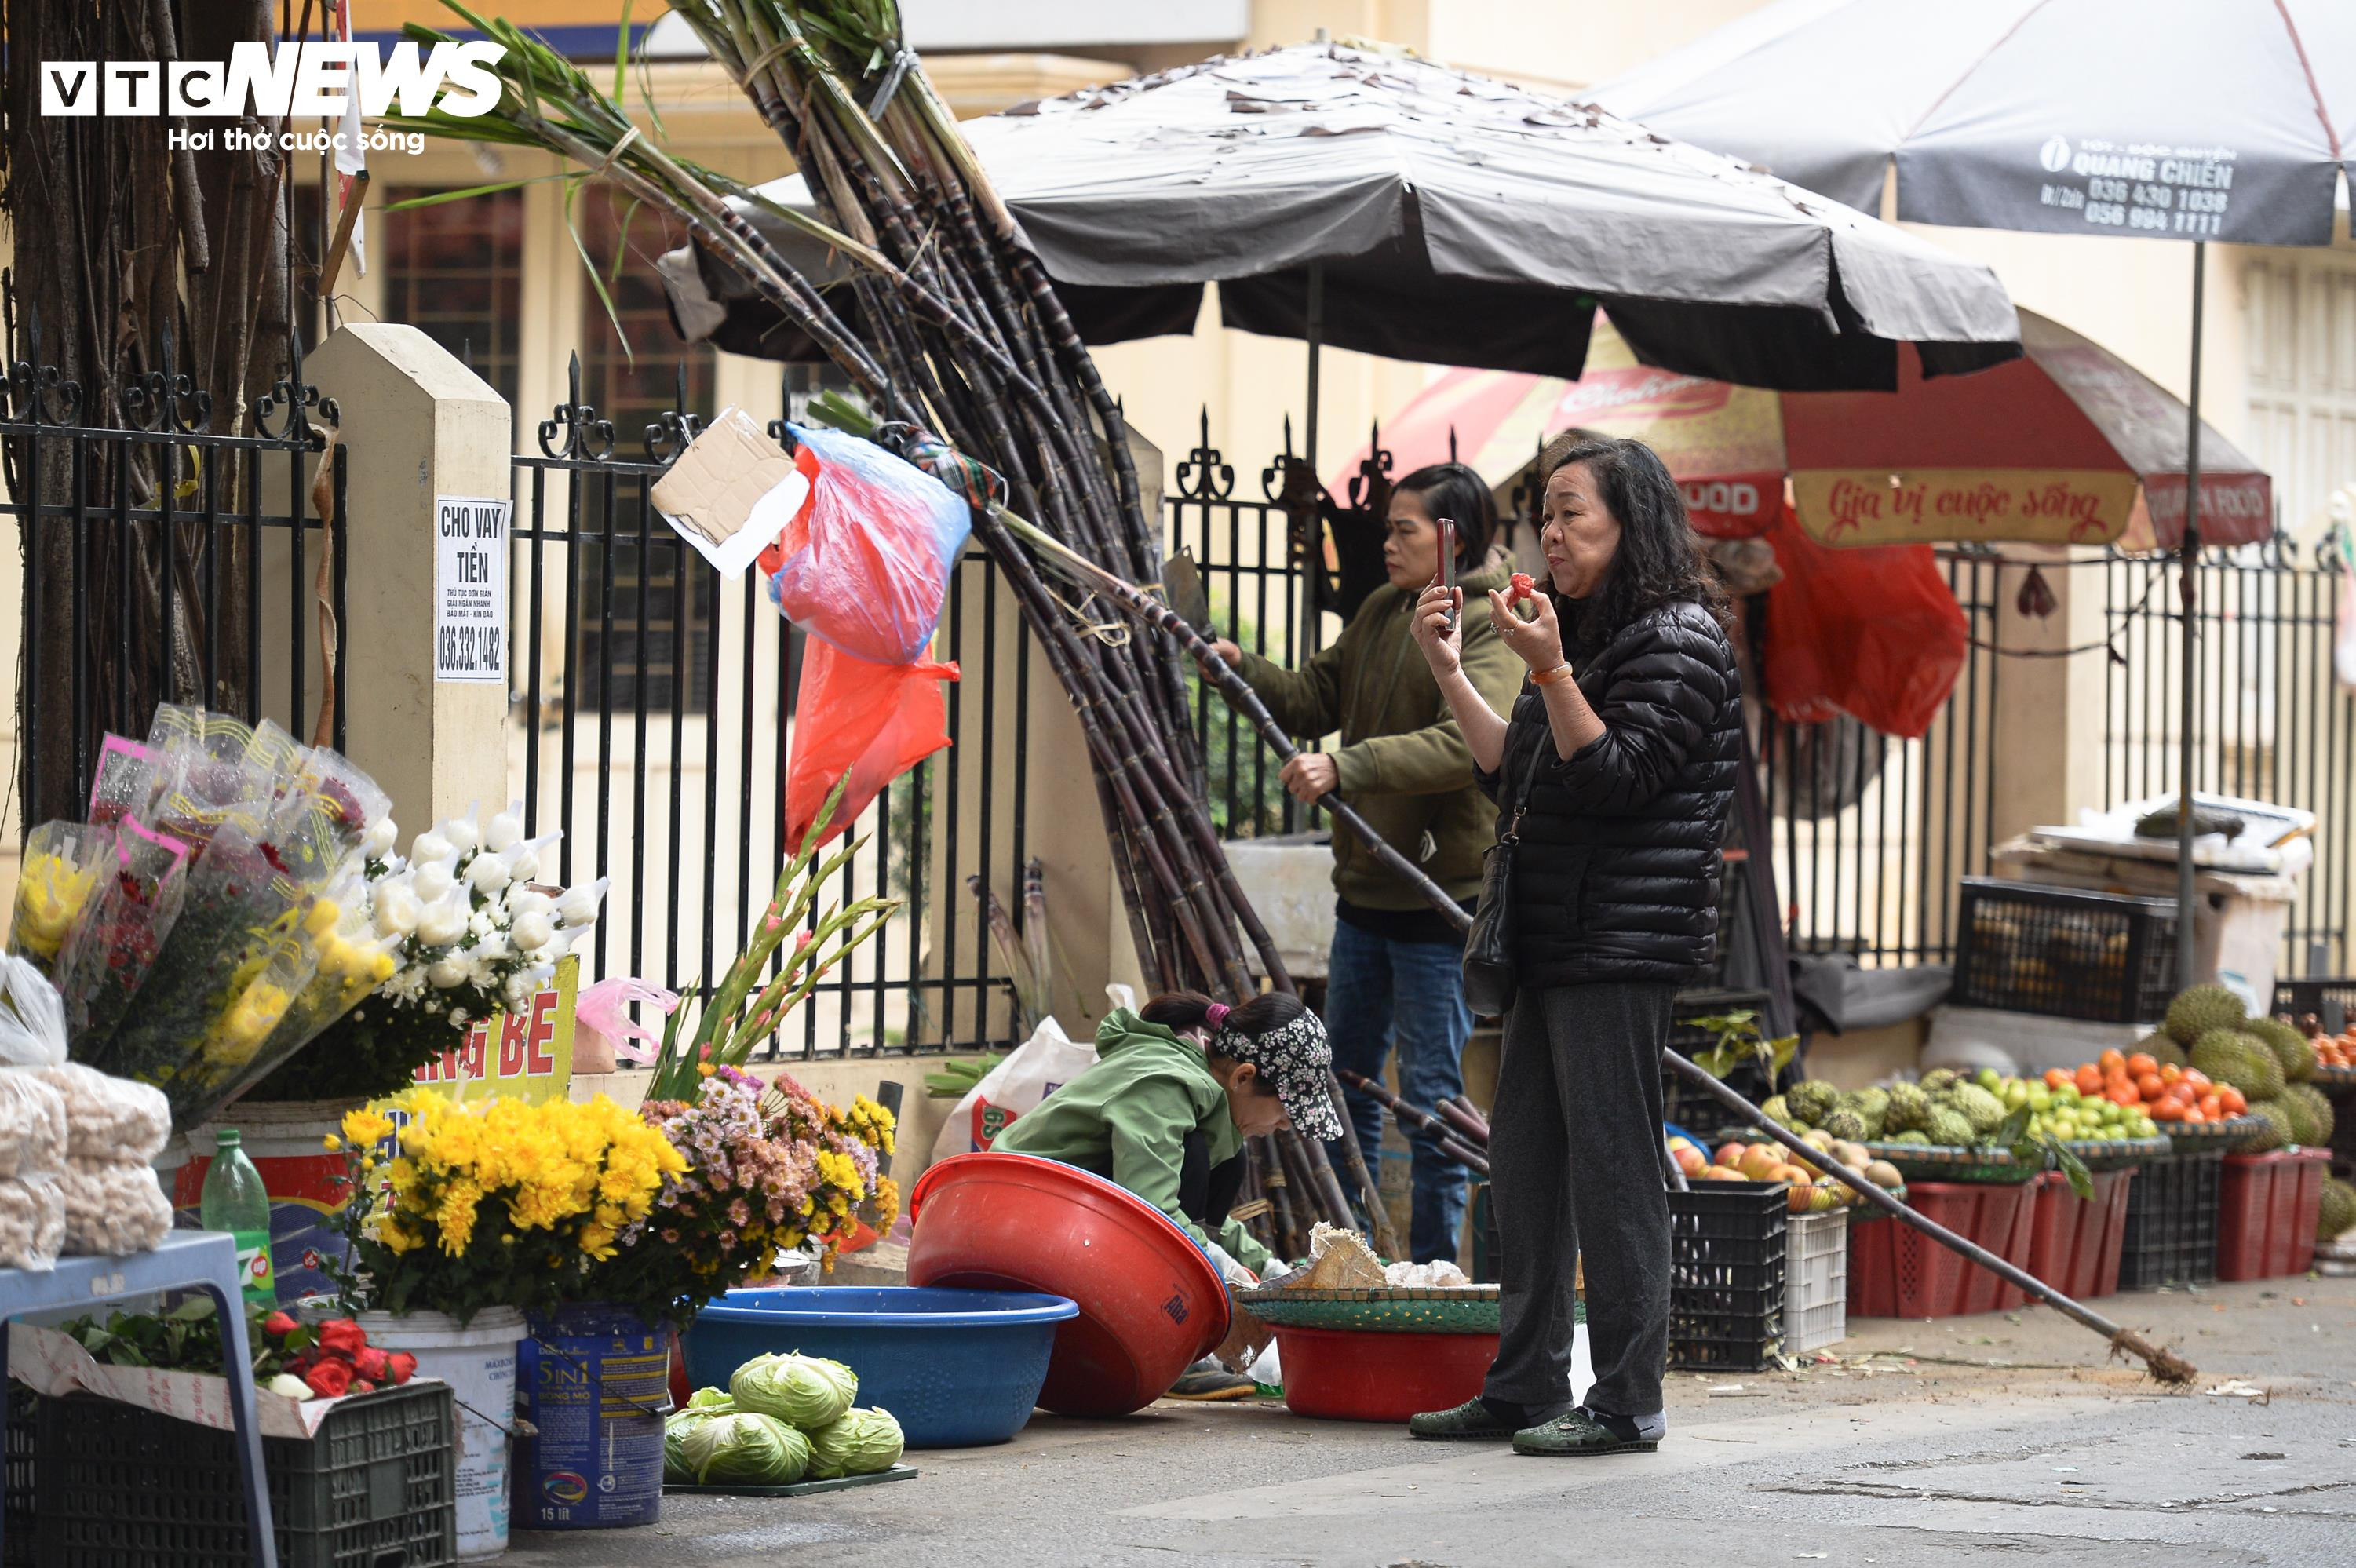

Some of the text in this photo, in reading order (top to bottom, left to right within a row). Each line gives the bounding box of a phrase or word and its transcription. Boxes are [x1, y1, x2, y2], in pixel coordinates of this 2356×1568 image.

[2073, 151, 2156, 181] QUANG
[2174, 211, 2222, 235] 1111
[1683, 481, 1759, 516] OOD
[1825, 477, 1883, 542] Gia
[1891, 483, 1927, 525] vị
[1936, 481, 2011, 525] cuộc
[2020, 480, 2108, 541] sống
[441, 506, 501, 538] CHO VAY
[457, 542, 488, 583] TIỀN
[439, 625, 500, 671] 036.332.1482
[541, 1508, 554, 1521] 15
